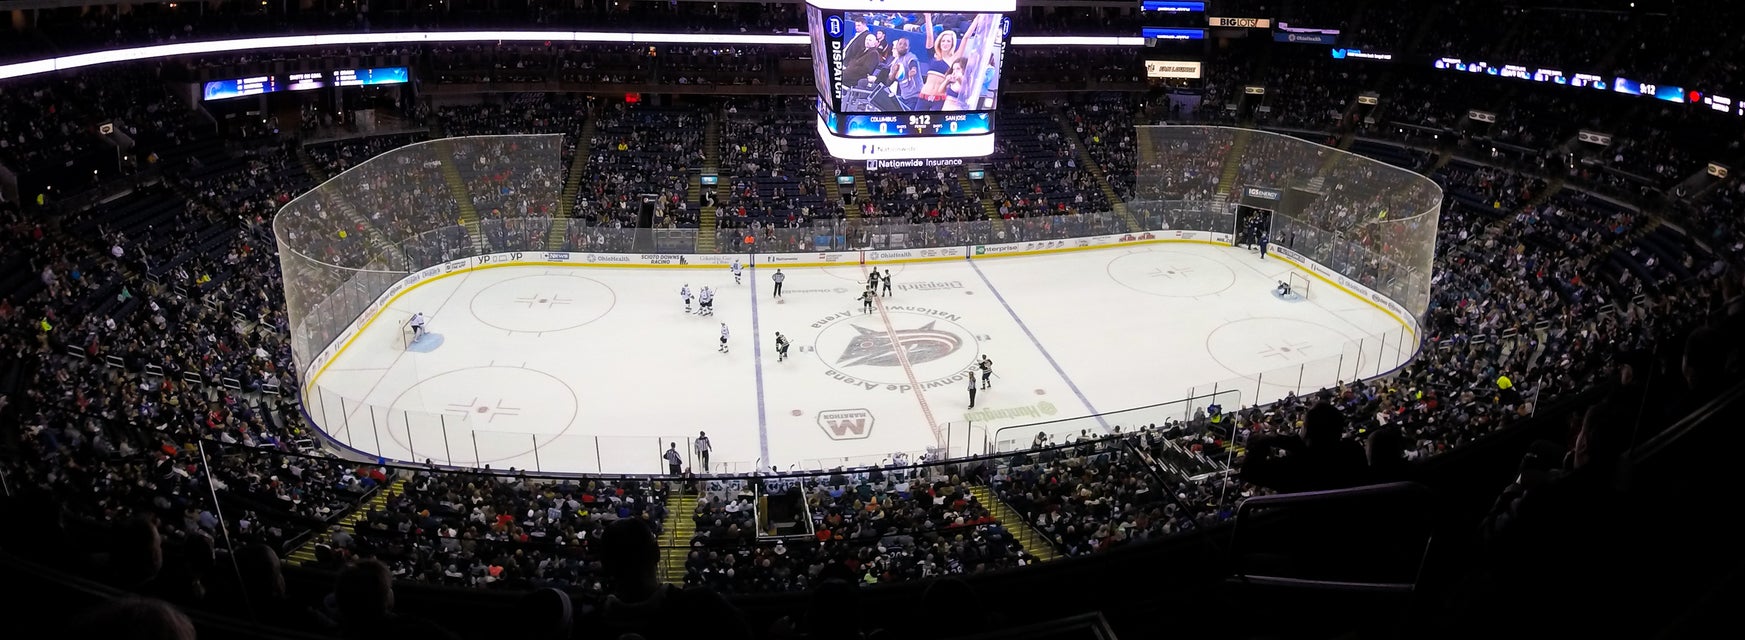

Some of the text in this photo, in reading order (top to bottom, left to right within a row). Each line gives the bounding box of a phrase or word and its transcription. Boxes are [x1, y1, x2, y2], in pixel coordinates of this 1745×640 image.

[1220, 18, 1236, 26] BIG
[831, 40, 842, 99] DISPATCH
[909, 115, 931, 125] 9:12
[879, 158, 962, 168] Nationwide Insurance
[810, 309, 852, 329] Arena
[825, 369, 878, 391] Arena
[823, 412, 866, 420] MARATHON
[963, 405, 1041, 422] Huntington
